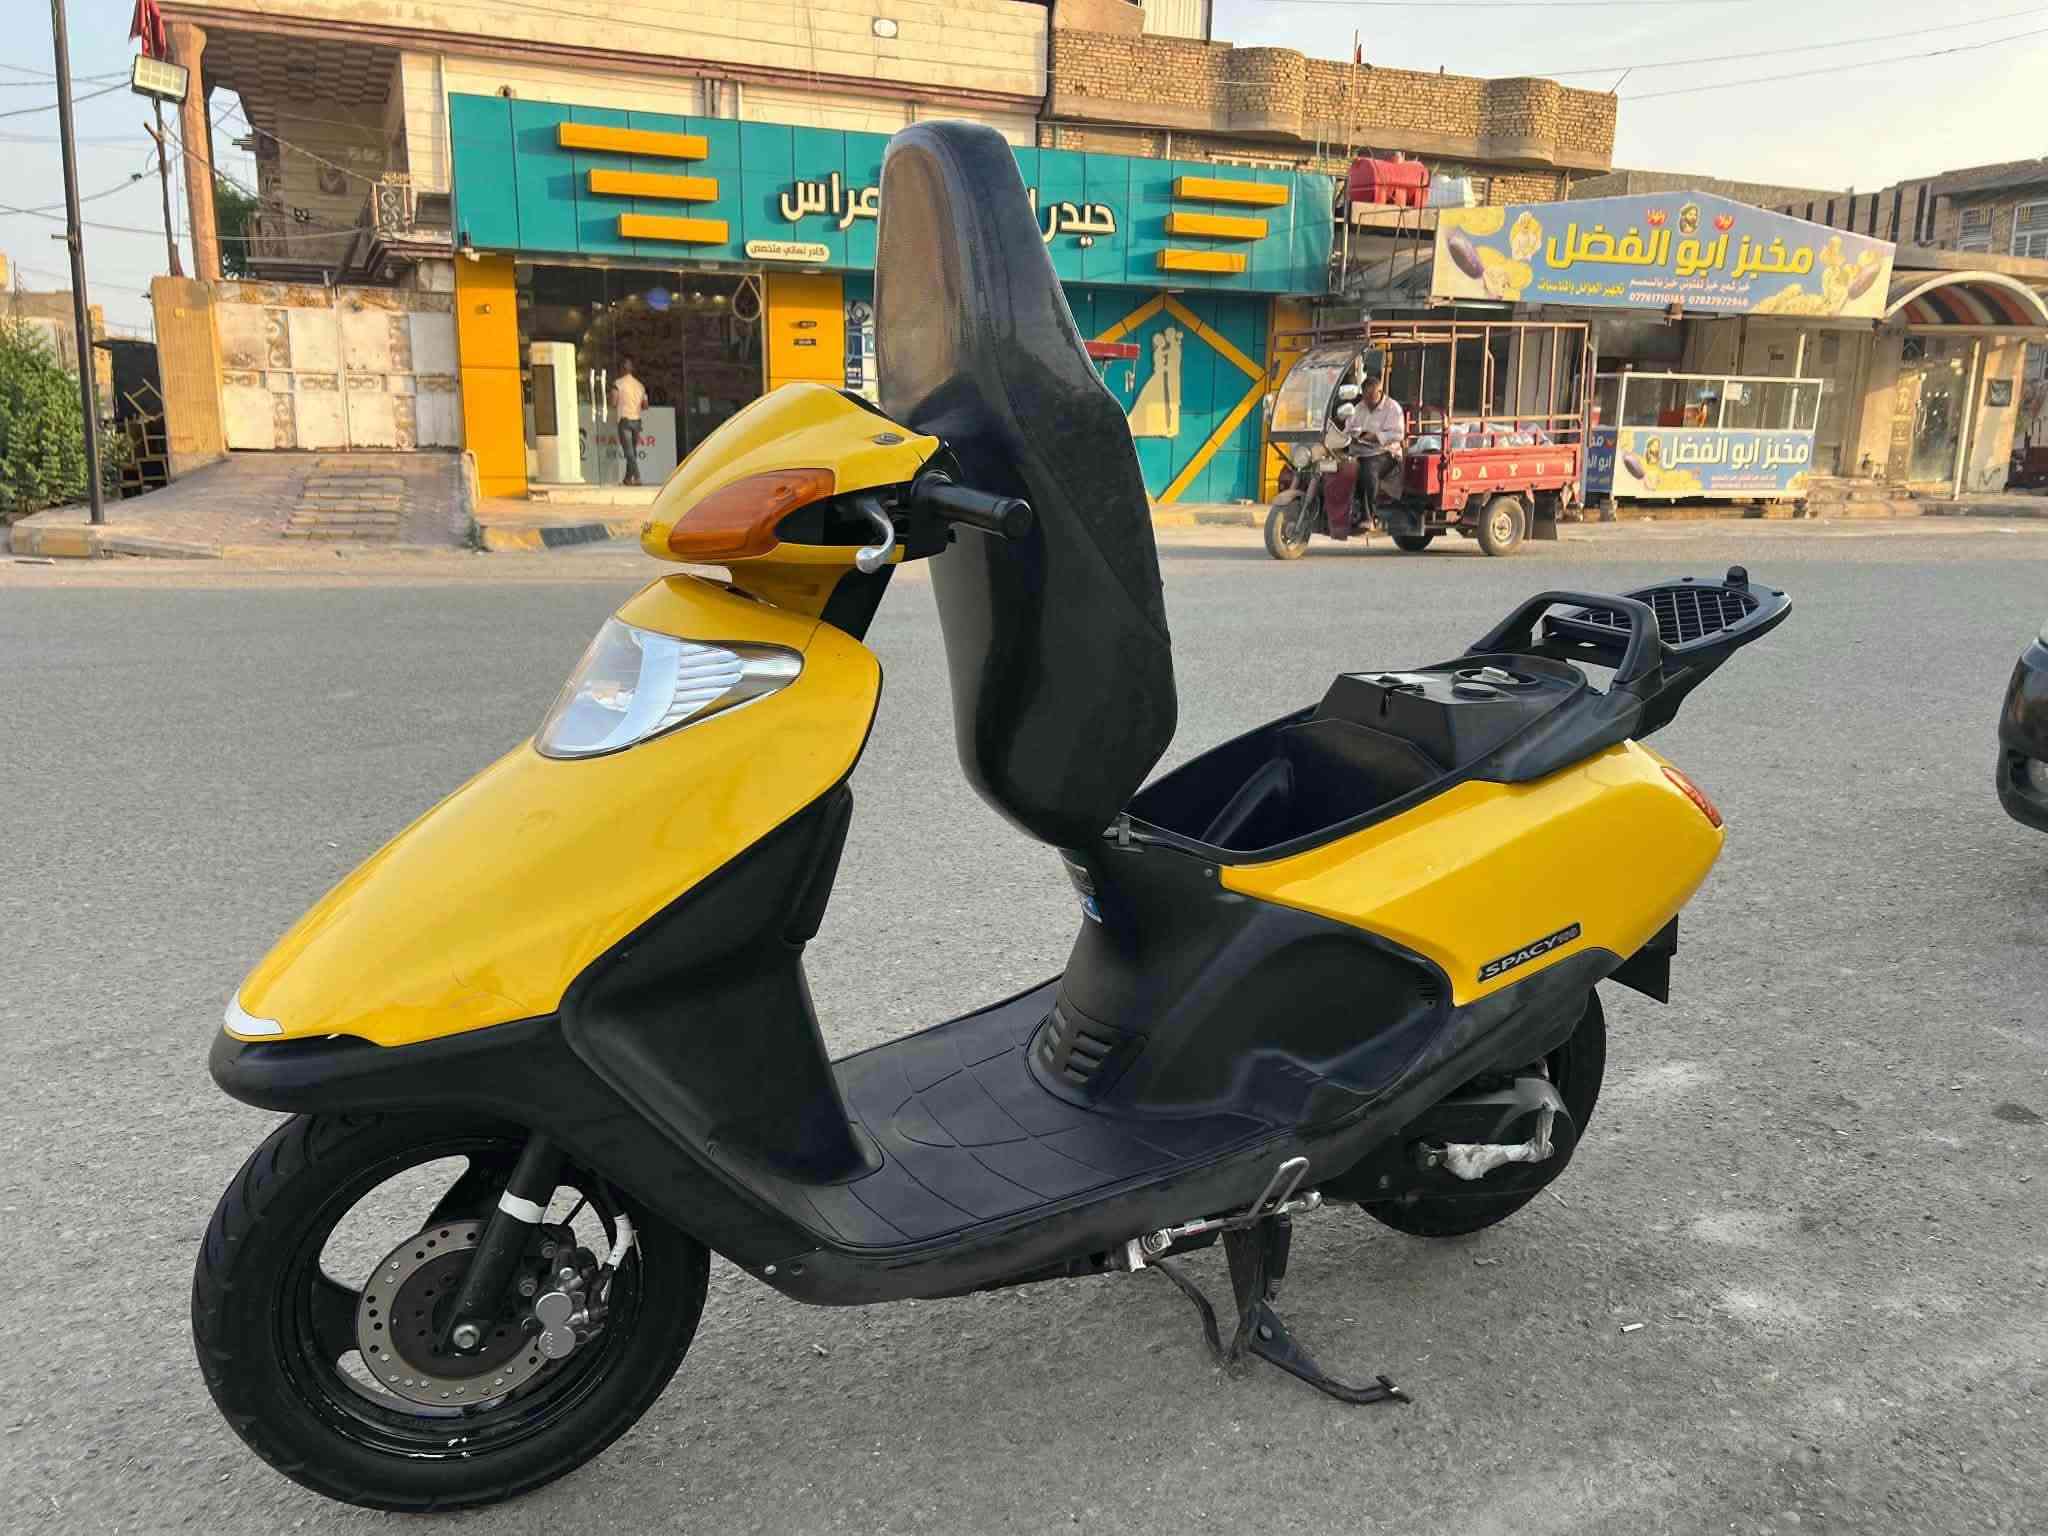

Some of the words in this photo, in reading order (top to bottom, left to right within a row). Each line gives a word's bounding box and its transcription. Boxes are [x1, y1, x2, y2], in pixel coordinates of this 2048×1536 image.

[1043, 202, 1116, 246] حيدر
[1546, 223, 1672, 269] الفضل
[1732, 235, 1815, 279] مخبز
[1662, 434, 1729, 469] الفضل
[1762, 436, 1809, 469] مخبز
[1485, 936, 1558, 977] SPACY
